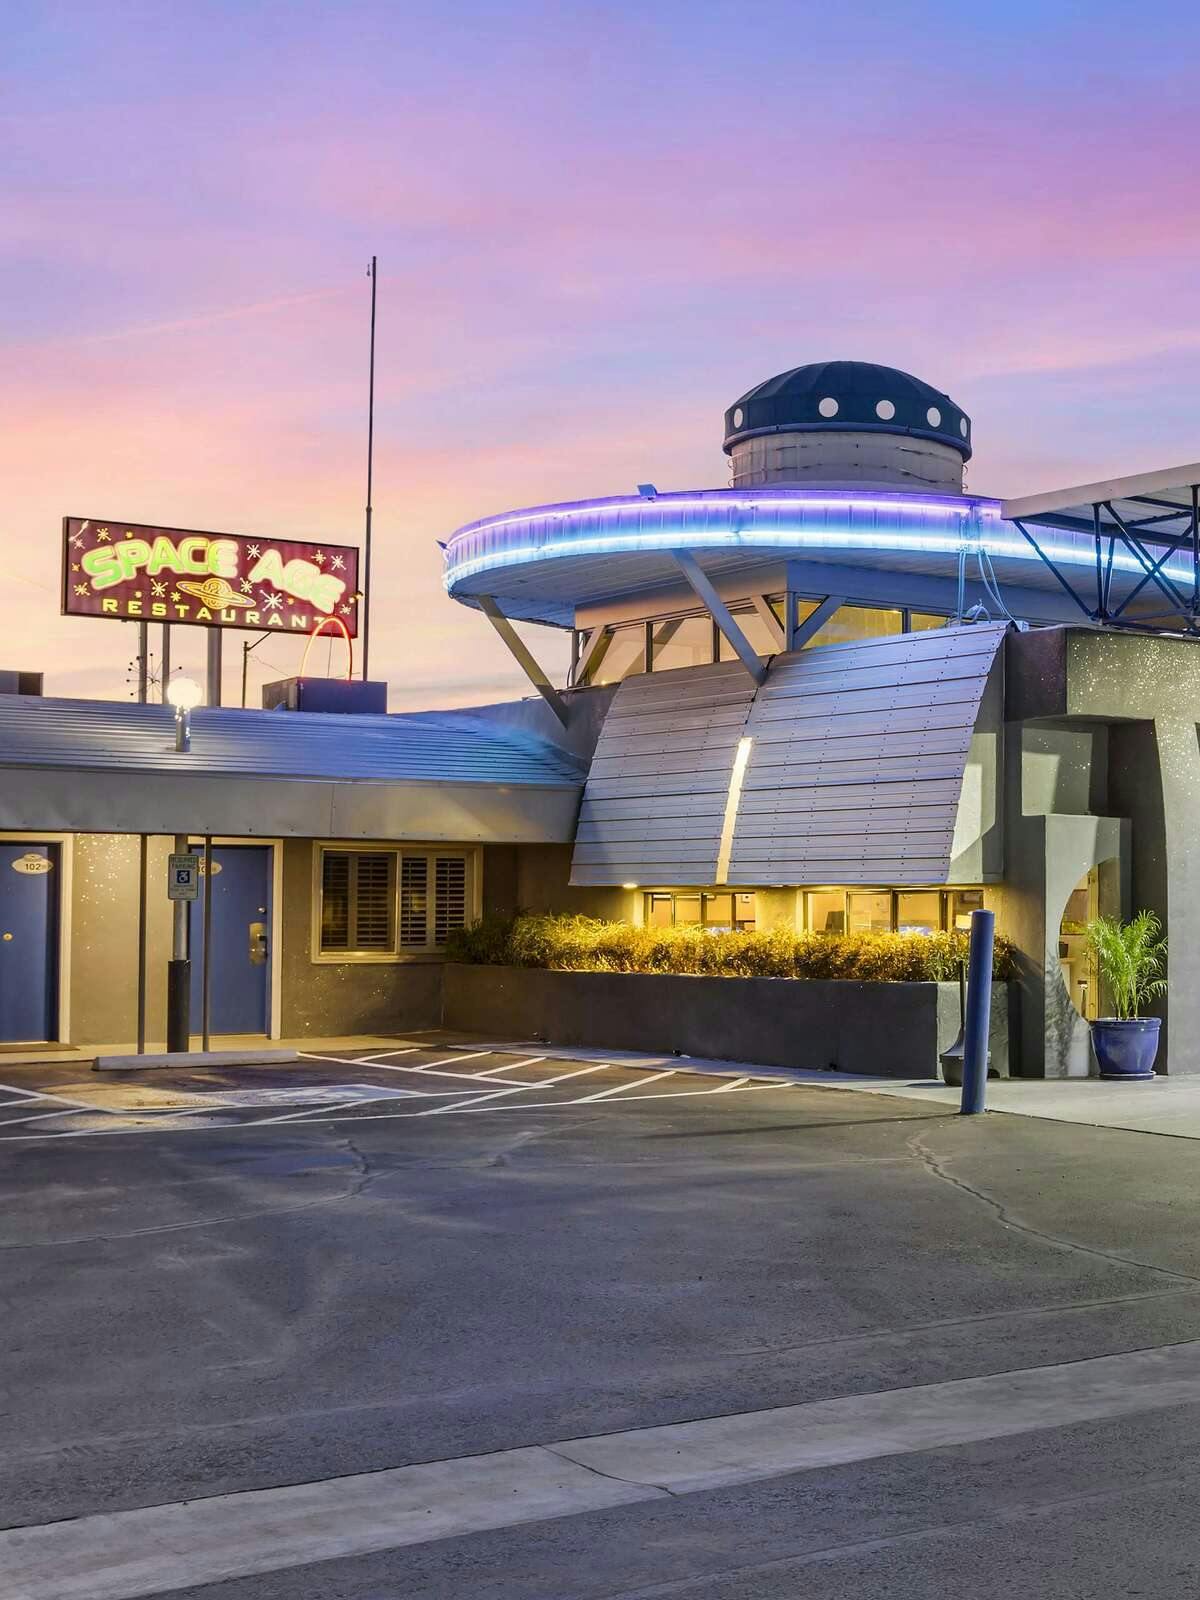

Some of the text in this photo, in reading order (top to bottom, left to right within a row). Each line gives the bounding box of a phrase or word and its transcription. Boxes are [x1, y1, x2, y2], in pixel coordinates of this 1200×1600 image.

[81, 536, 346, 614] SPACE AGE
[102, 598, 326, 629] RESTAURANT
[25, 863, 41, 871] 102
